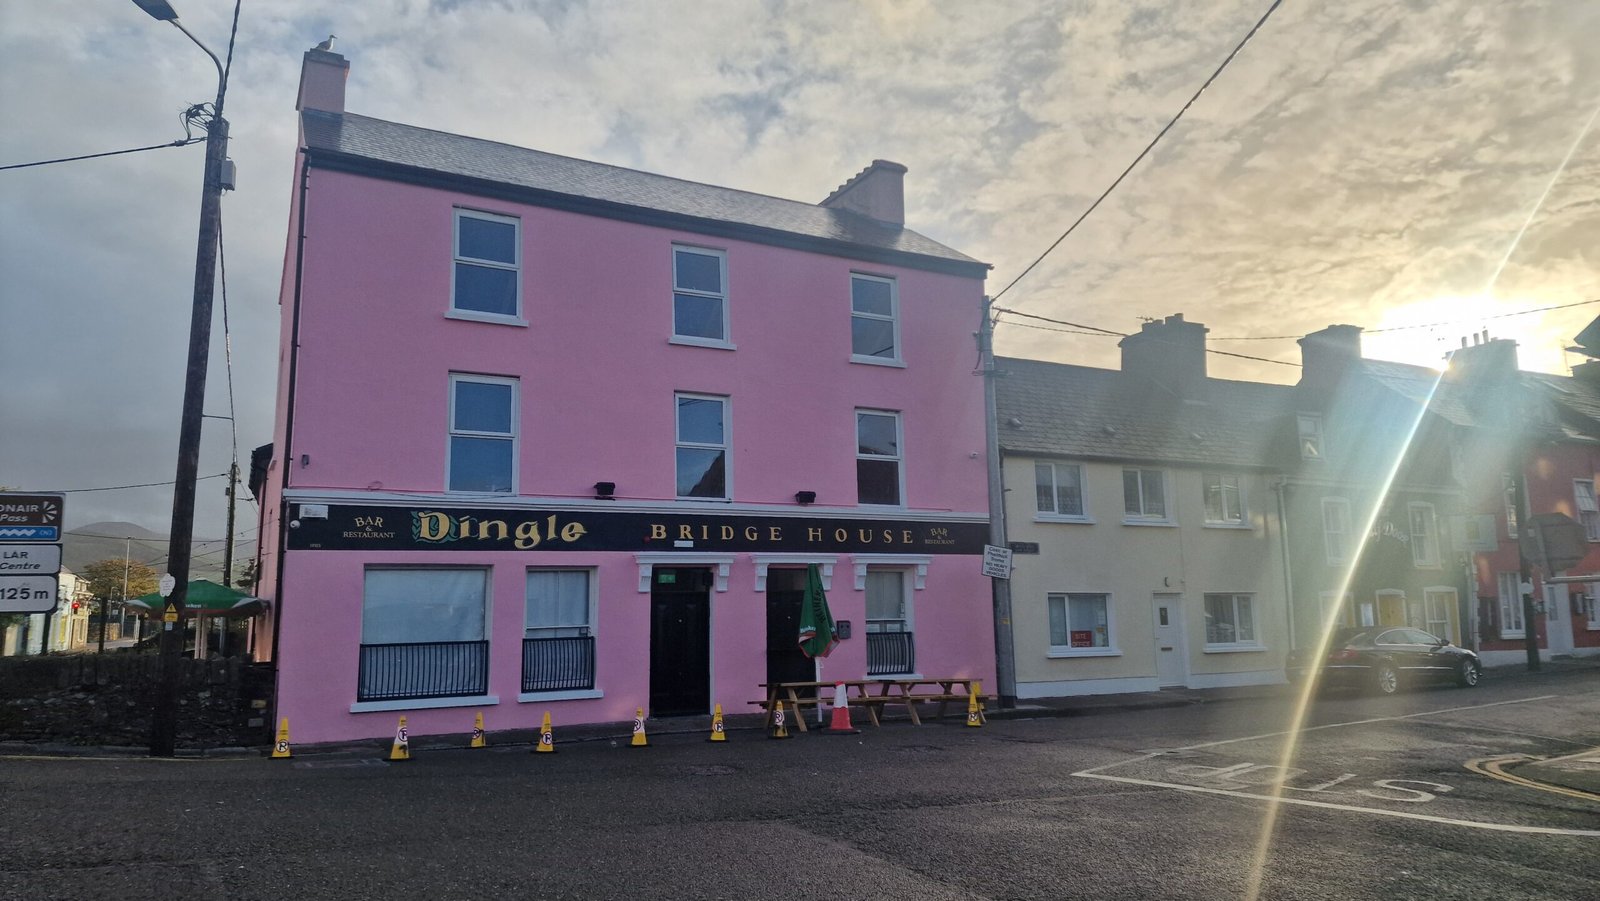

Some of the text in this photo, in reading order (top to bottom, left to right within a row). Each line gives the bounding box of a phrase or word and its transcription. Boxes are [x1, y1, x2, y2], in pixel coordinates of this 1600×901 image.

[0, 513, 28, 522] Pass
[354, 516, 384, 527] BAR
[418, 511, 914, 549] Dingle BRIDGE HOUSE
[930, 527, 948, 536] BAR
[0, 562, 41, 570] Centre
[0, 588, 48, 600] 125 m
